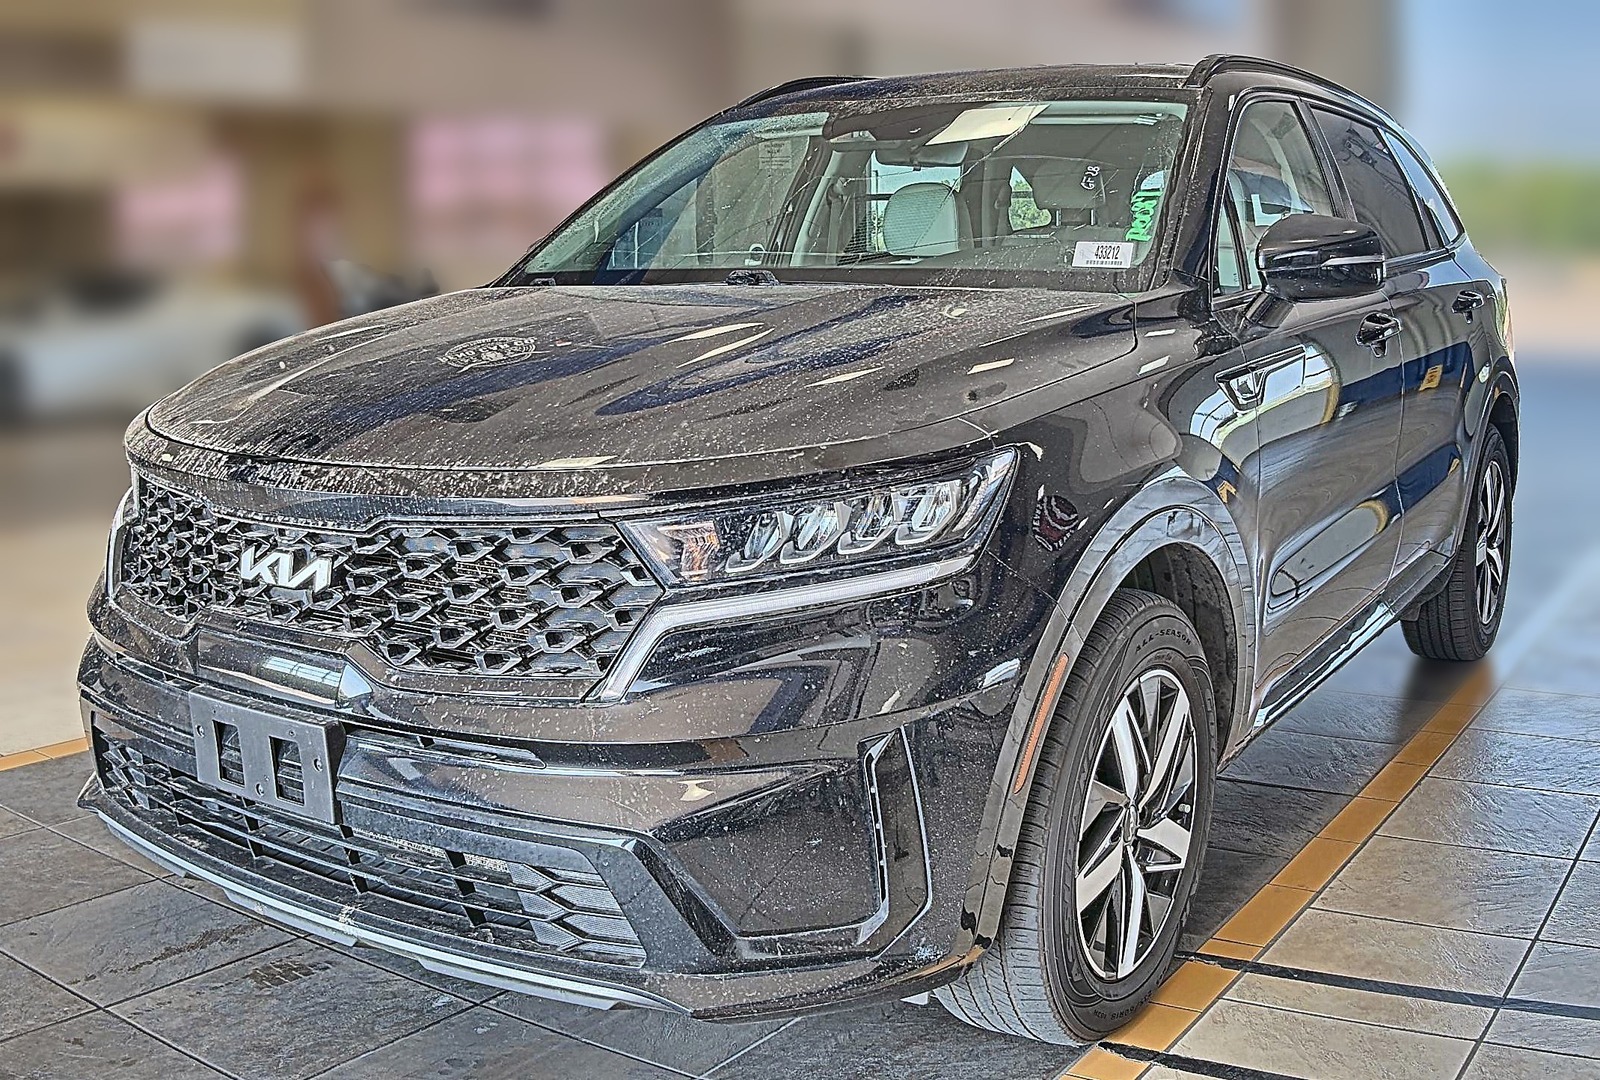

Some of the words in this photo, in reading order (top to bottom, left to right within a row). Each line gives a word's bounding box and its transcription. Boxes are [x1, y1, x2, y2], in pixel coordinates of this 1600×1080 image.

[1094, 245, 1121, 260] 433212
[241, 545, 333, 594] KIA
[1135, 628, 1191, 653] ALL-SEASON
